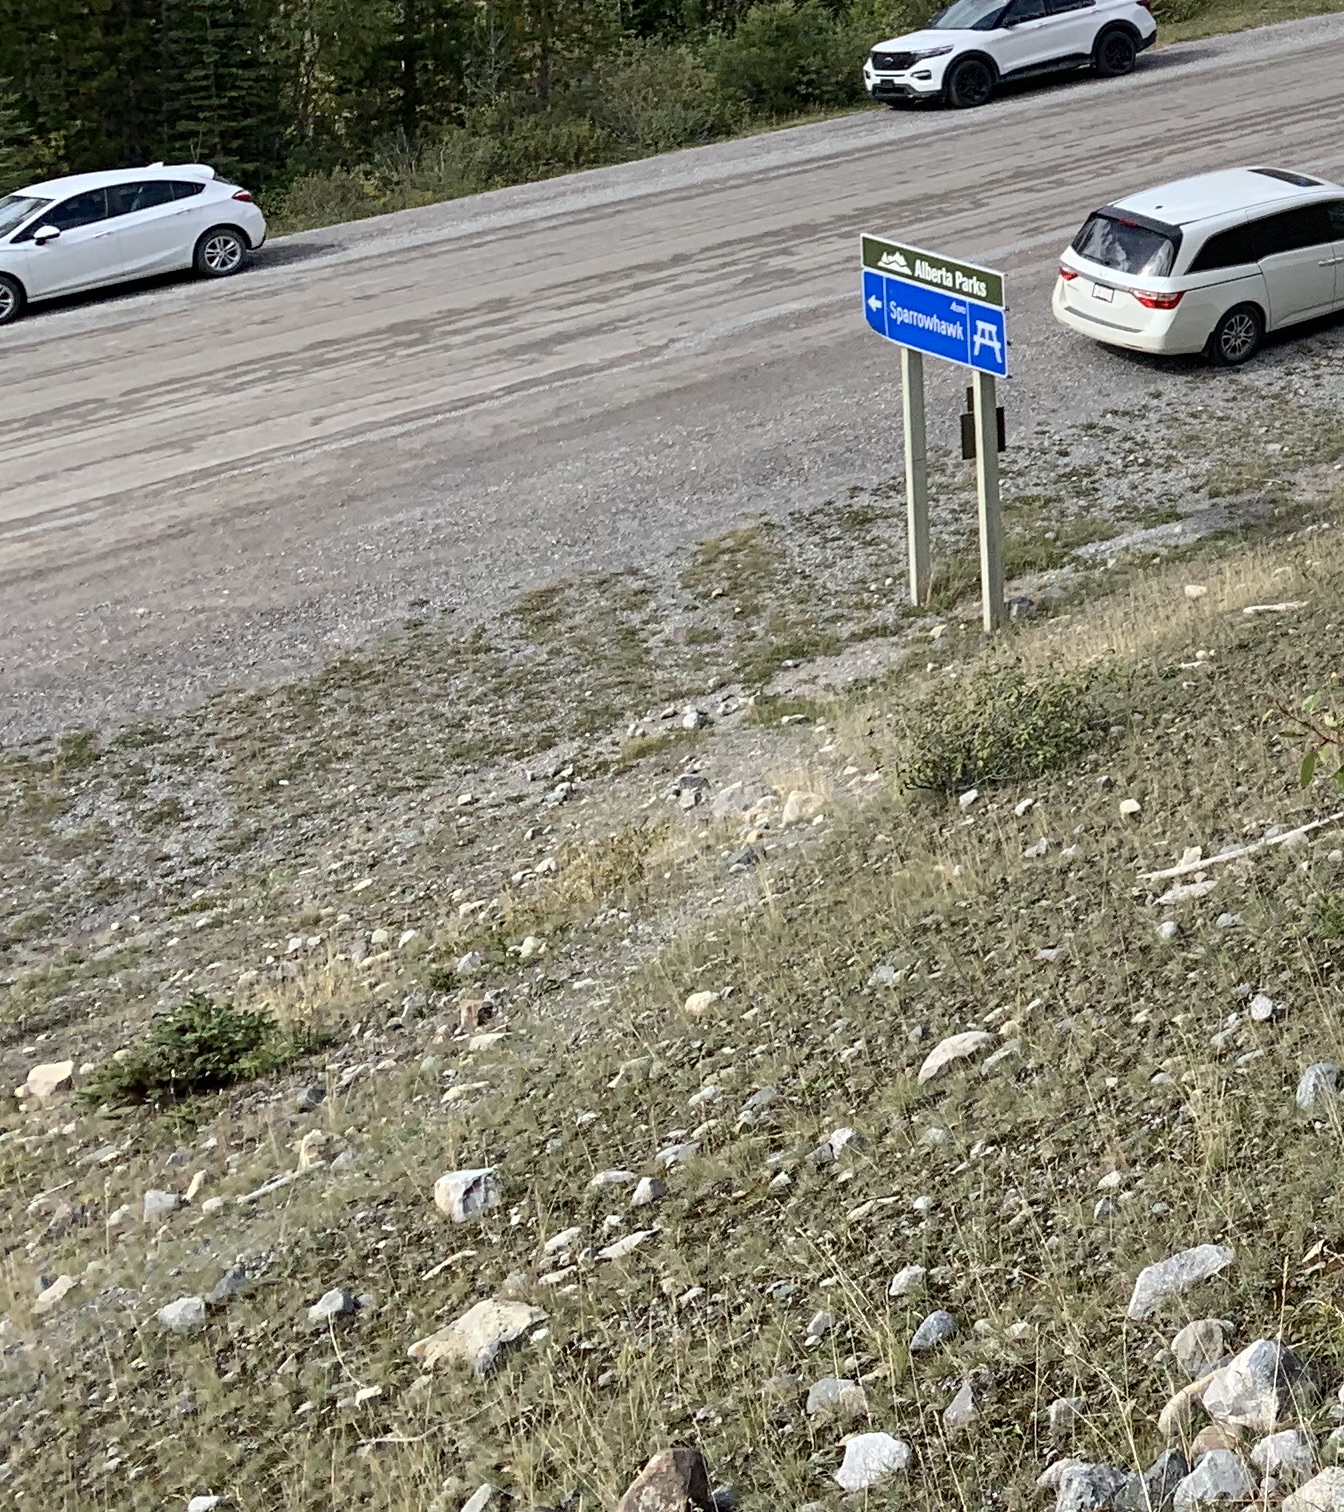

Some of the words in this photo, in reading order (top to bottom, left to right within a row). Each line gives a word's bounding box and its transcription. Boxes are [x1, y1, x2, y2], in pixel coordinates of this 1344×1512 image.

[914, 259, 953, 287] Alberta
[955, 271, 987, 298] Parks
[889, 300, 964, 340] Sparrowhawk
